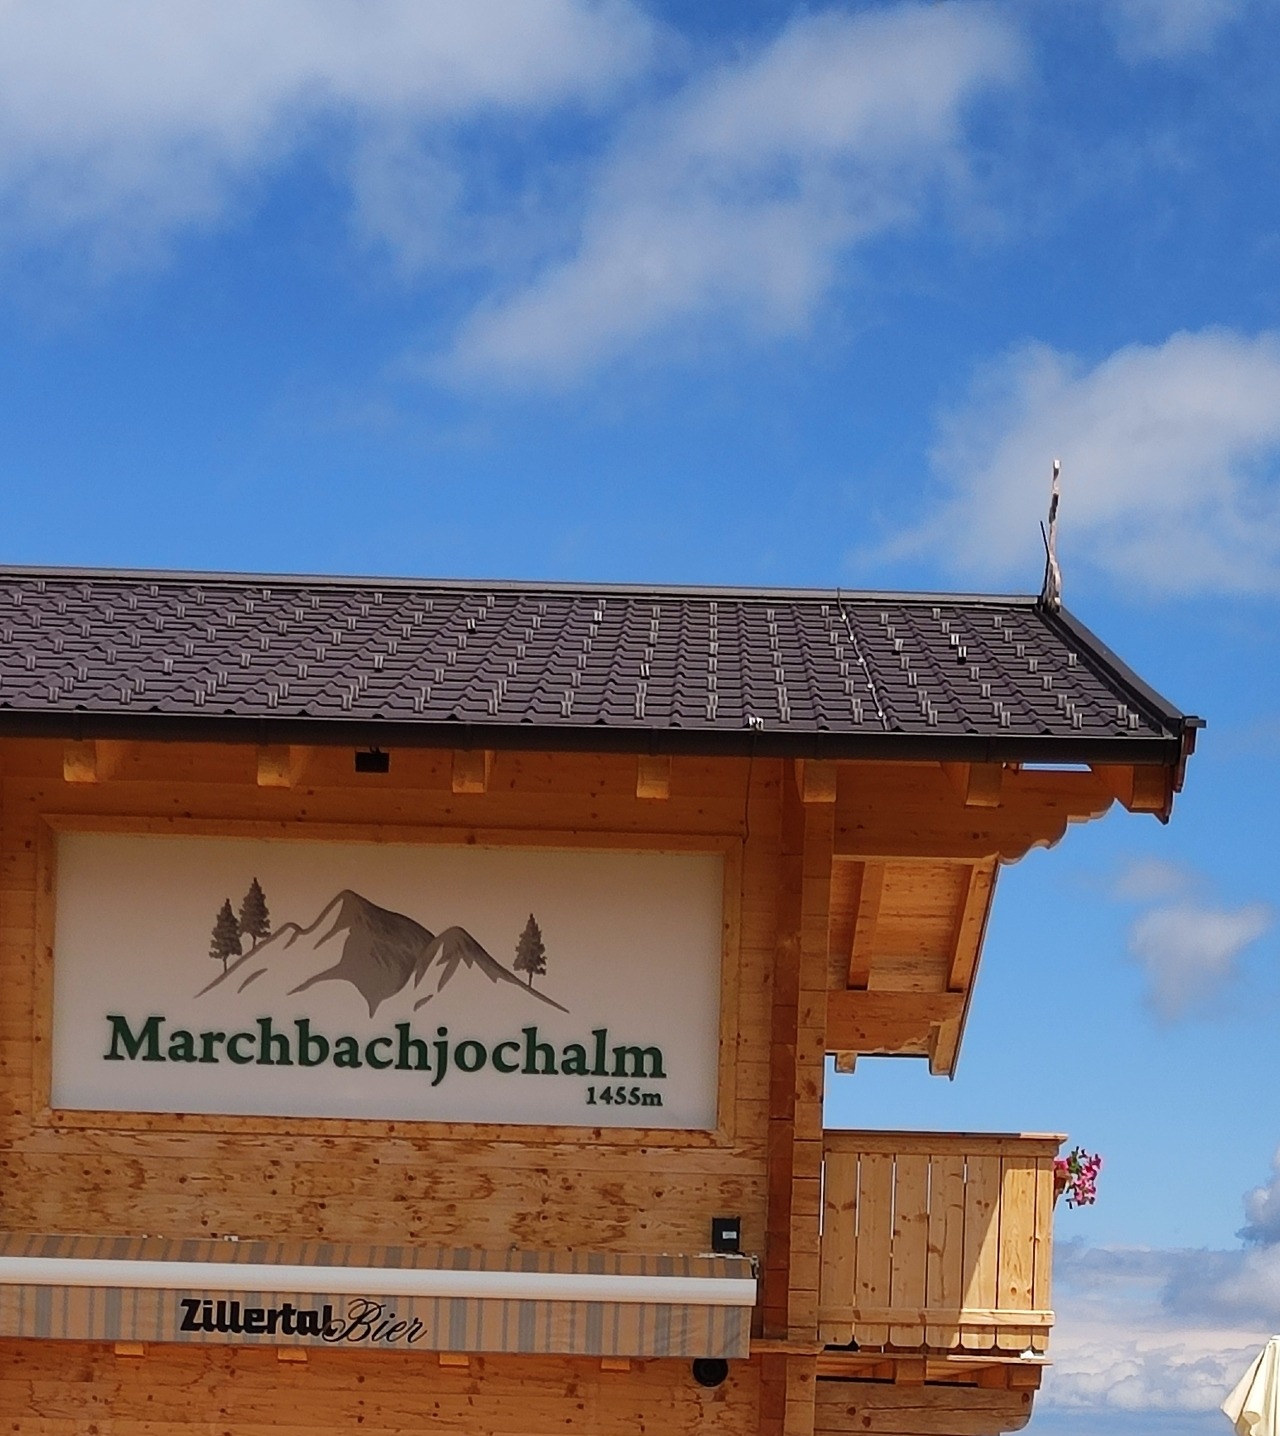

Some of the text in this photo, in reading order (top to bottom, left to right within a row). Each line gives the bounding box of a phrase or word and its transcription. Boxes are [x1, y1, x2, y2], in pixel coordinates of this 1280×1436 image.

[104, 1014, 667, 1086] Marchbachjochalm
[585, 1086, 663, 1107] 1455m
[180, 1298, 427, 1343] Zillertal Bier
